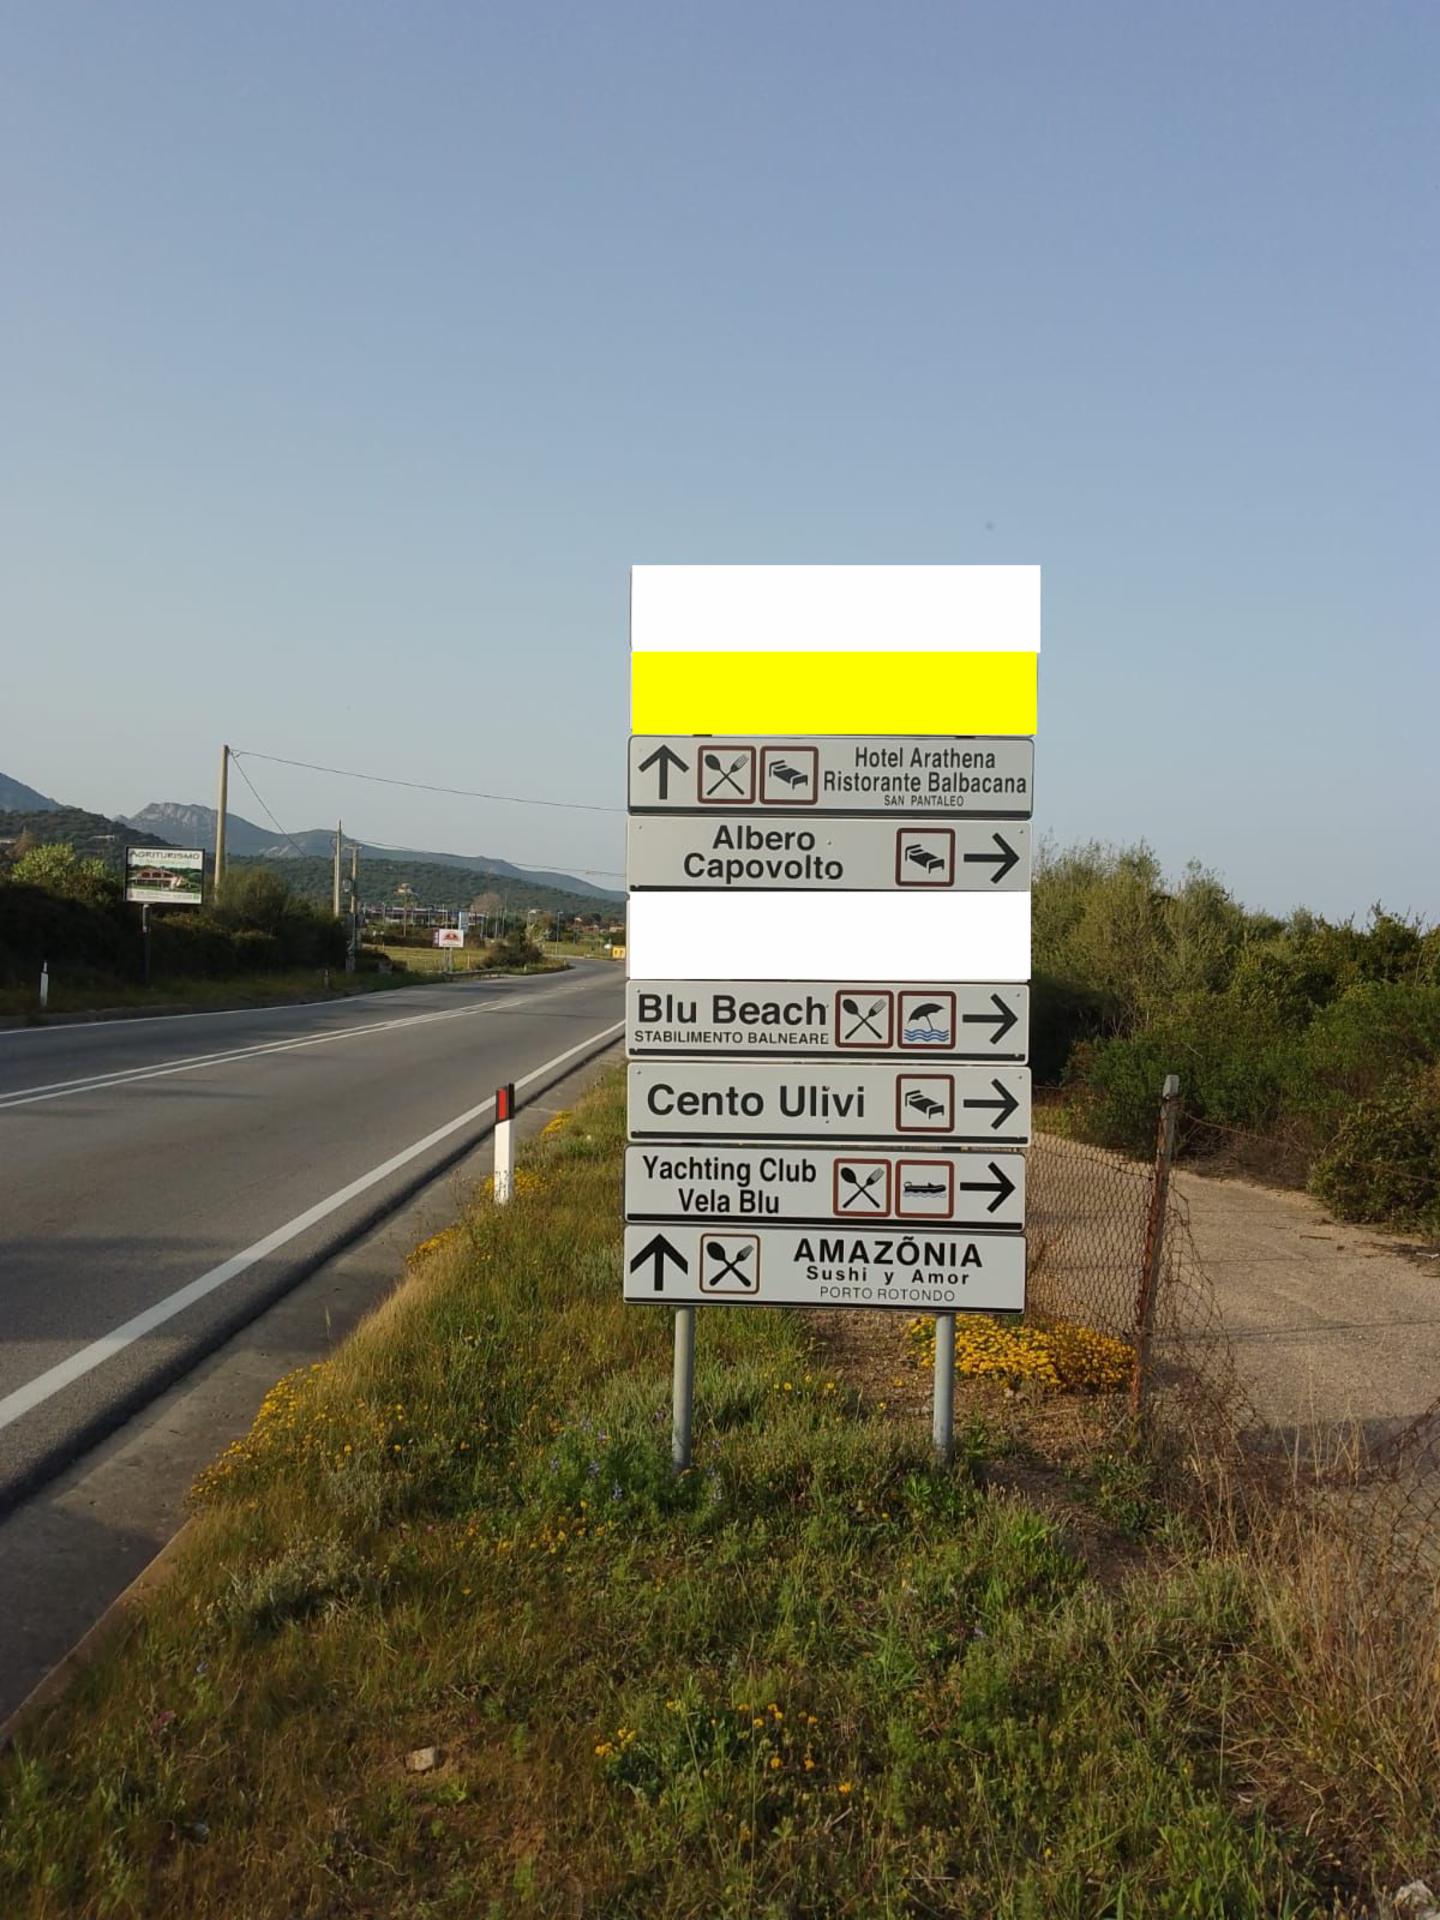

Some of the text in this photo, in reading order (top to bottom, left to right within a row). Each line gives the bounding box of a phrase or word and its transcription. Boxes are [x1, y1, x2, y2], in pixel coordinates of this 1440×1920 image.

[855, 747, 996, 769] Hotel Arathena
[823, 771, 1027, 794] Ristorante Balbacana
[884, 795, 965, 807] SAN PANTALEO
[713, 825, 816, 852] Albero
[684, 853, 844, 884] Capovolto
[638, 993, 827, 1026] Blu Beach
[634, 1030, 829, 1045] STABILIMENTO BALNEARE
[647, 1083, 865, 1118] Cento Ulivi
[643, 1155, 817, 1187] Yachting Club
[678, 1188, 780, 1214] Vela Blu
[793, 1235, 984, 1268] AMAZÕNIA
[807, 1266, 971, 1285] Sushi y Amor
[820, 1286, 956, 1302] PORTO ROTONDO
